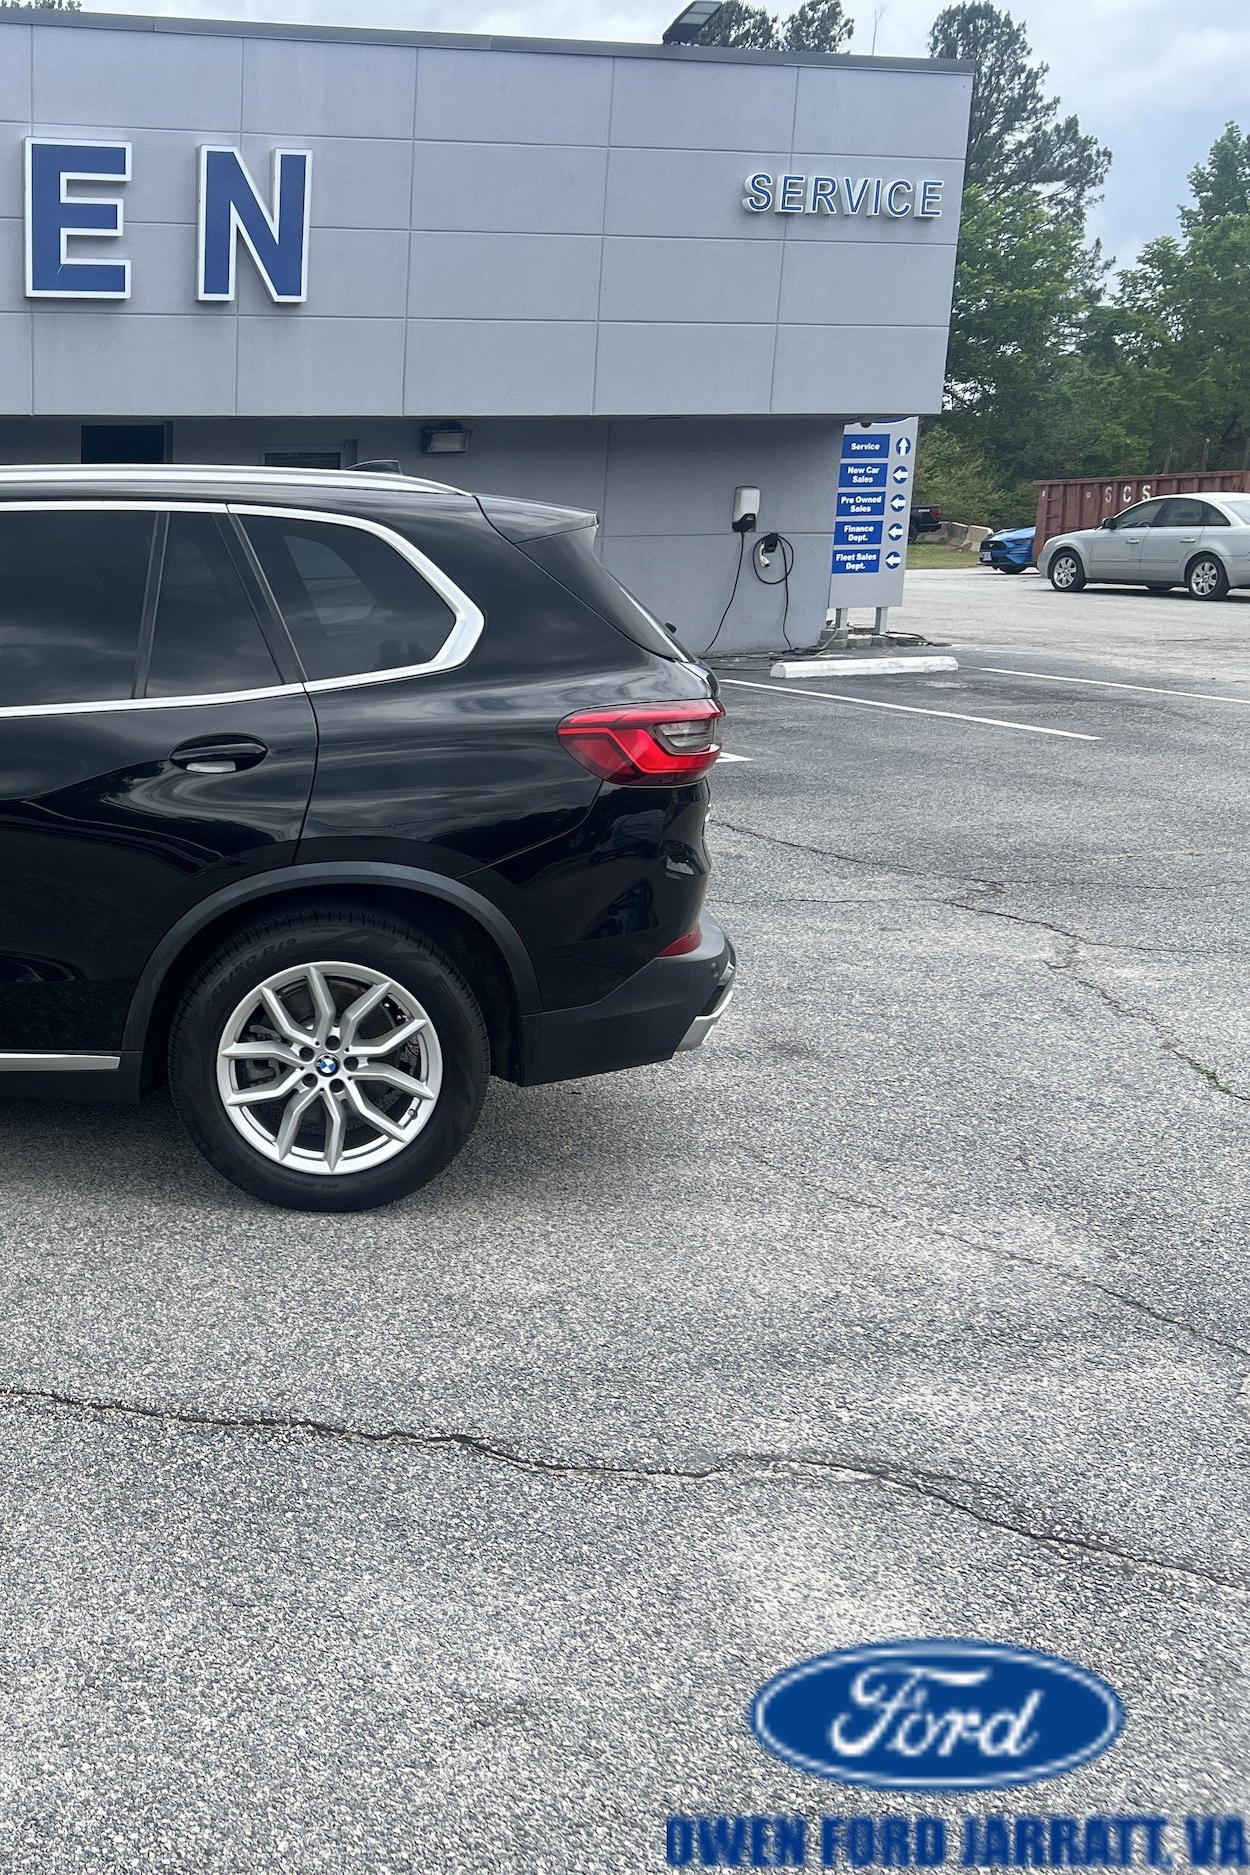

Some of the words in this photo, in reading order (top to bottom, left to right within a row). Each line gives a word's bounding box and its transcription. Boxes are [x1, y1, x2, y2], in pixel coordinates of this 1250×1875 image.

[742, 172, 944, 218] SERVICE
[851, 442, 880, 451] Service
[848, 466, 864, 474] New
[866, 466, 879, 474] Car
[852, 475, 873, 483] Sales
[841, 496, 854, 504] Pre
[856, 496, 882, 504] Owned
[850, 505, 871, 513] Sales
[844, 525, 874, 533] Finance
[848, 533, 868, 543] Dept.
[836, 553, 855, 561] Fleet
[856, 553, 877, 561] Sales
[846, 562, 866, 571] Dept.
